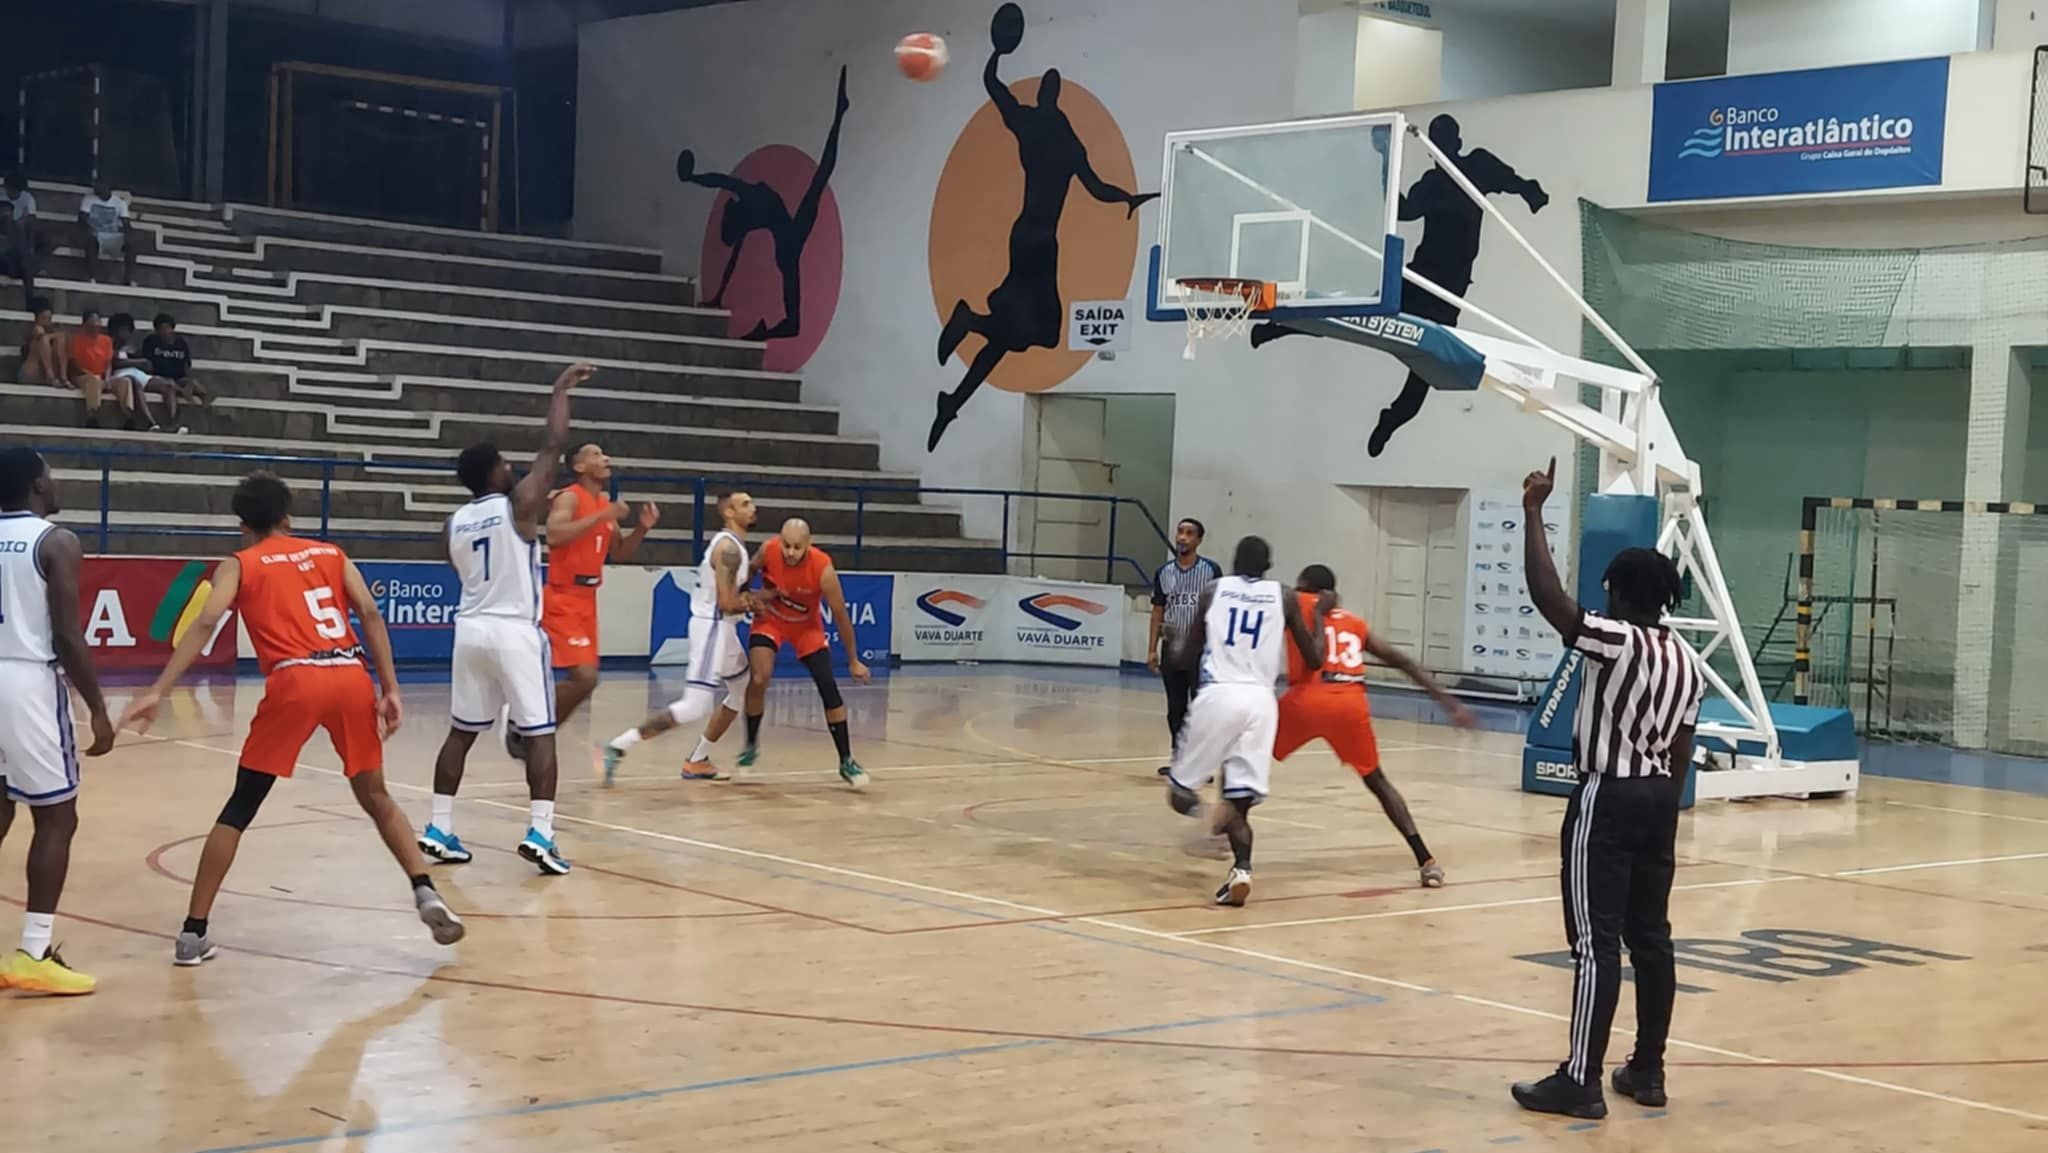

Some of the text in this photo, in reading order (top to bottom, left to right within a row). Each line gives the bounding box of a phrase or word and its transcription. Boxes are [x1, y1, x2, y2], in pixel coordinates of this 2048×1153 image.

[1726, 106, 1778, 125] Banco
[1725, 114, 1913, 151] Interatlântico
[1075, 306, 1125, 321] SAÍDA
[1080, 323, 1119, 336] EXIT
[472, 536, 490, 582] 7
[389, 580, 443, 598] Banco
[303, 586, 347, 640] 5
[944, 630, 984, 642] DUARTE
[1224, 607, 1265, 650] 14
[1053, 633, 1105, 648] DUARTE
[1325, 626, 1364, 668] 13
